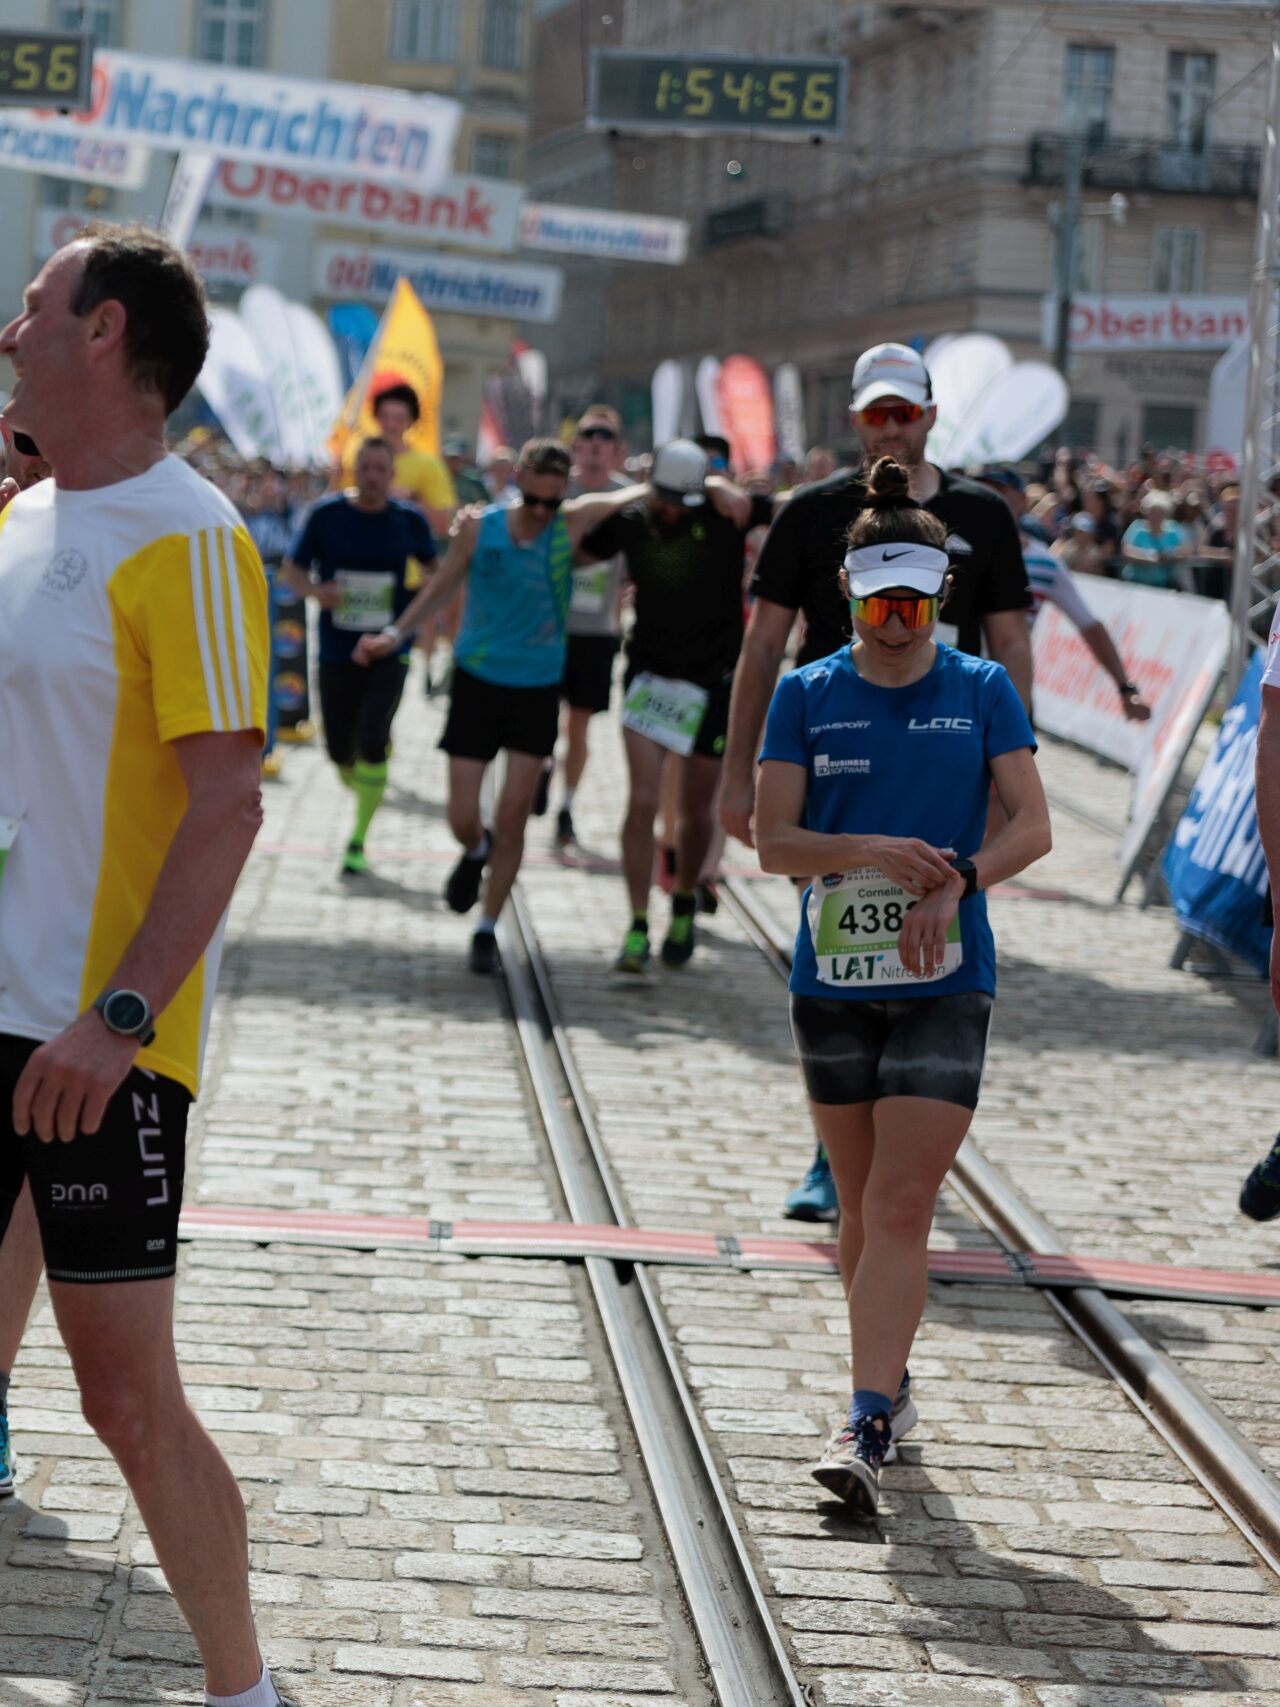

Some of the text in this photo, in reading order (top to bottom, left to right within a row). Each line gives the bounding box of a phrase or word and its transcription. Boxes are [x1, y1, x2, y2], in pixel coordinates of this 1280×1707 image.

[655, 68, 835, 121] 1:54:56
[1069, 298, 1250, 344] Oberban
[907, 717, 973, 731] LAC
[829, 759, 870, 768] BUSINESS
[829, 766, 870, 776] SOFTWARE
[847, 873, 888, 881] MARATHO
[857, 886, 904, 899] Cornelia
[838, 901, 919, 936] 438
[831, 955, 877, 981] LAT
